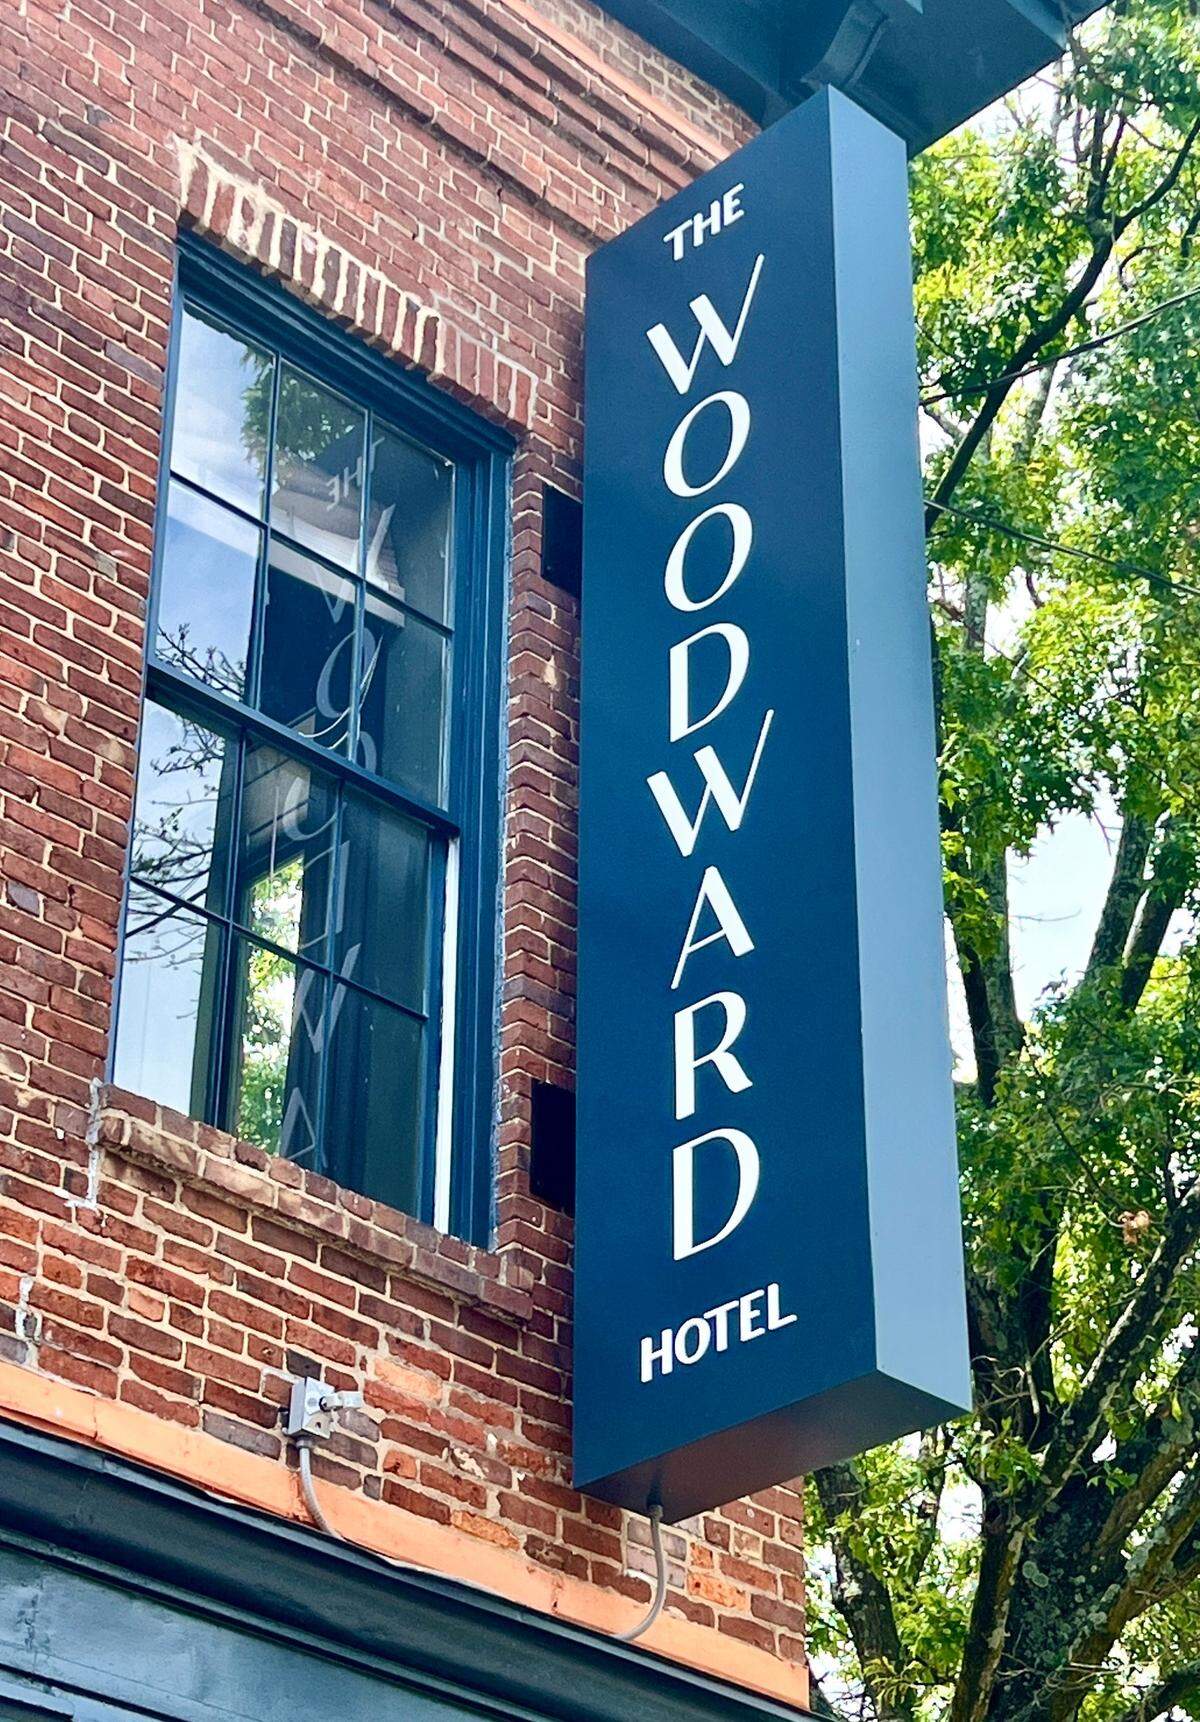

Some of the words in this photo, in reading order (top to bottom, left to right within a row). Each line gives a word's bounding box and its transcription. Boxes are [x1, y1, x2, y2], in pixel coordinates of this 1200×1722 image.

[664, 183, 745, 261] THE
[646, 254, 775, 1261] WOODWARD
[640, 1283, 798, 1383] HOTEL
